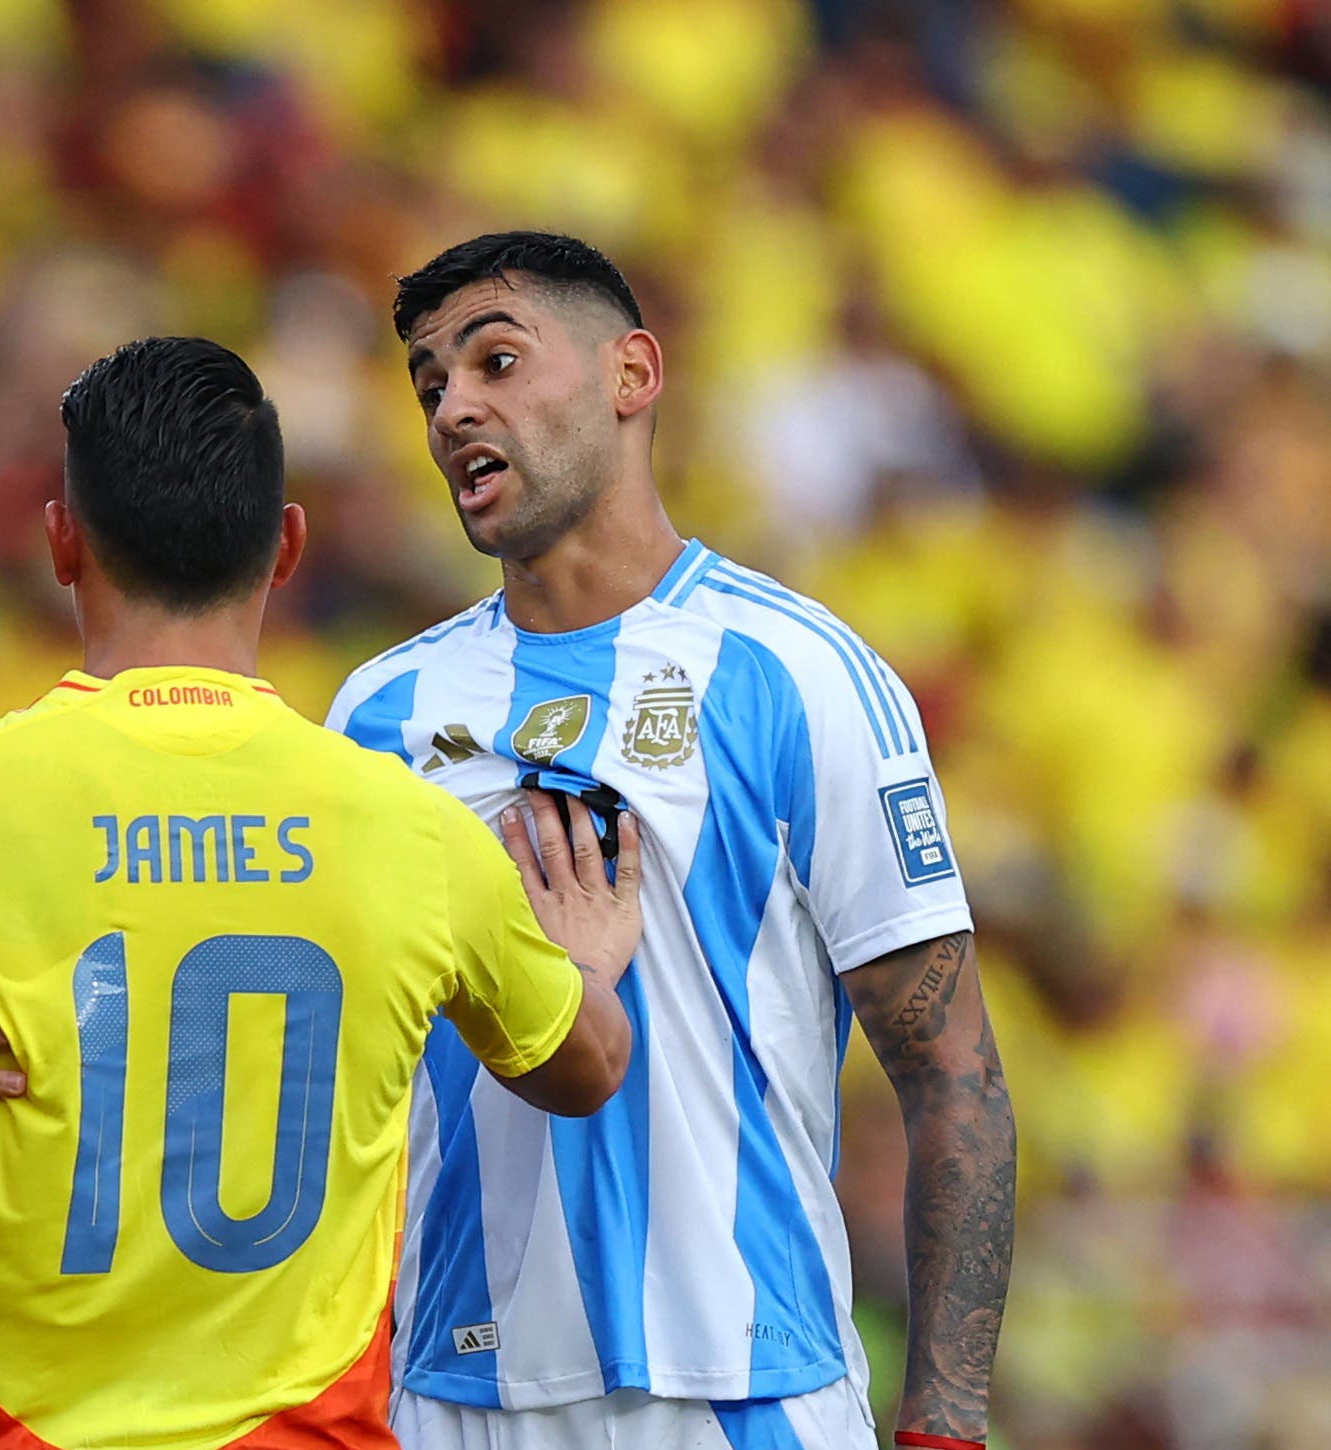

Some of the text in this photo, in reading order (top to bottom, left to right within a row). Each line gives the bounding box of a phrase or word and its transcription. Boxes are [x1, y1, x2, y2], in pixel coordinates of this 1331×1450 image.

[127, 686, 234, 708] COLOMBIA
[91, 814, 315, 885] JAMES
[59, 931, 344, 1276] 10
